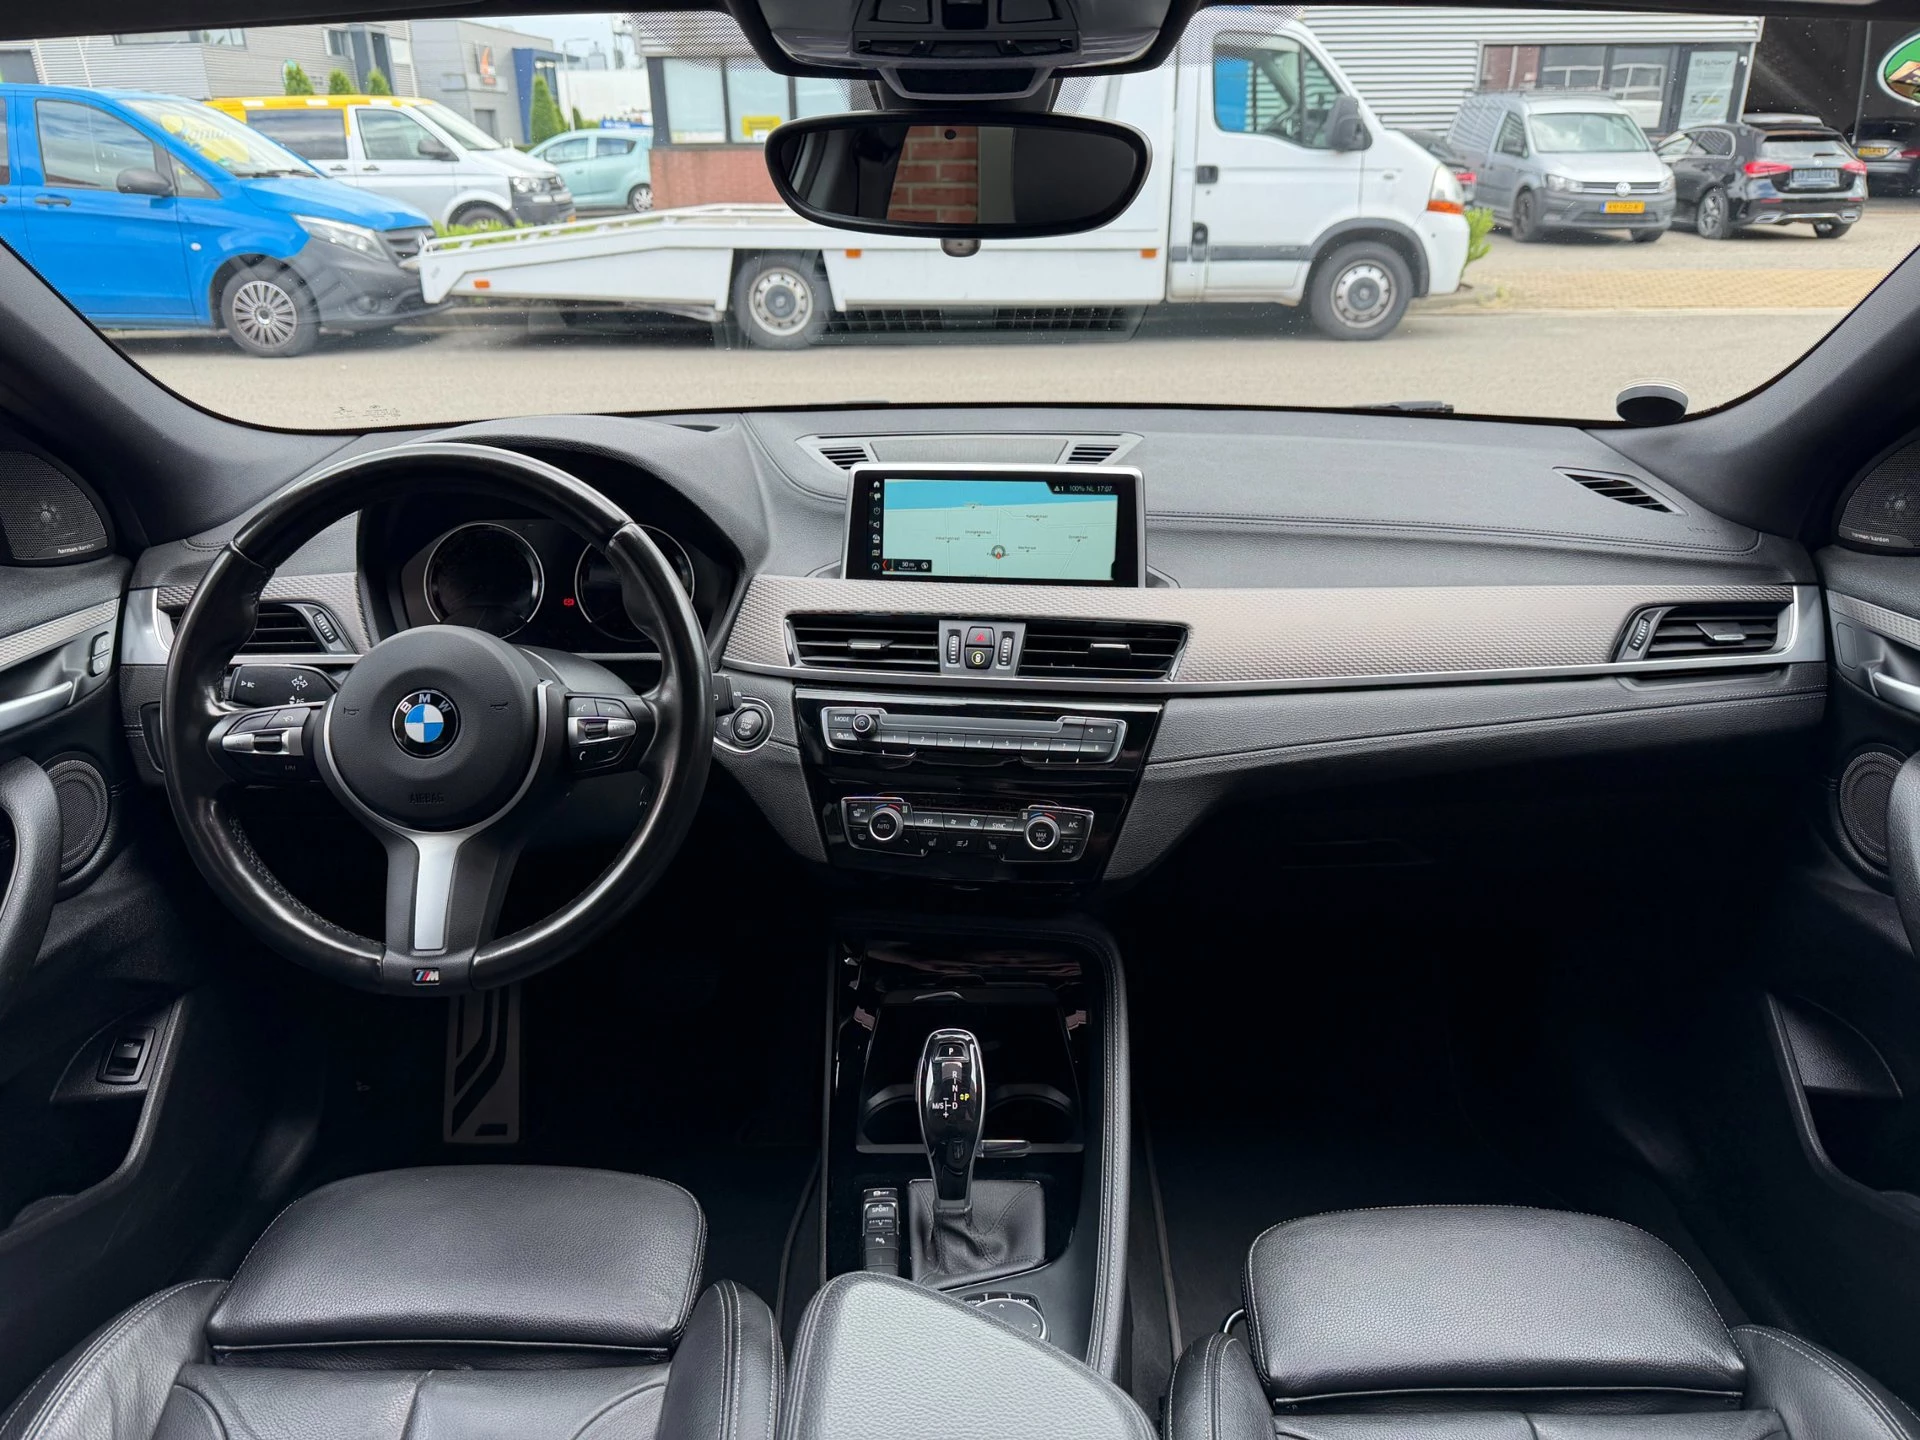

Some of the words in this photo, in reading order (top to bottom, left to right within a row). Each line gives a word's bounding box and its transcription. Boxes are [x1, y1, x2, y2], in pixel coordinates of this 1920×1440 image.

[399, 693, 452, 714] BMW
[948, 1047, 954, 1056] P
[952, 1070, 958, 1078] R
[952, 1084, 958, 1092] N
[931, 1102, 944, 1110] M/S
[952, 1102, 958, 1110] D
